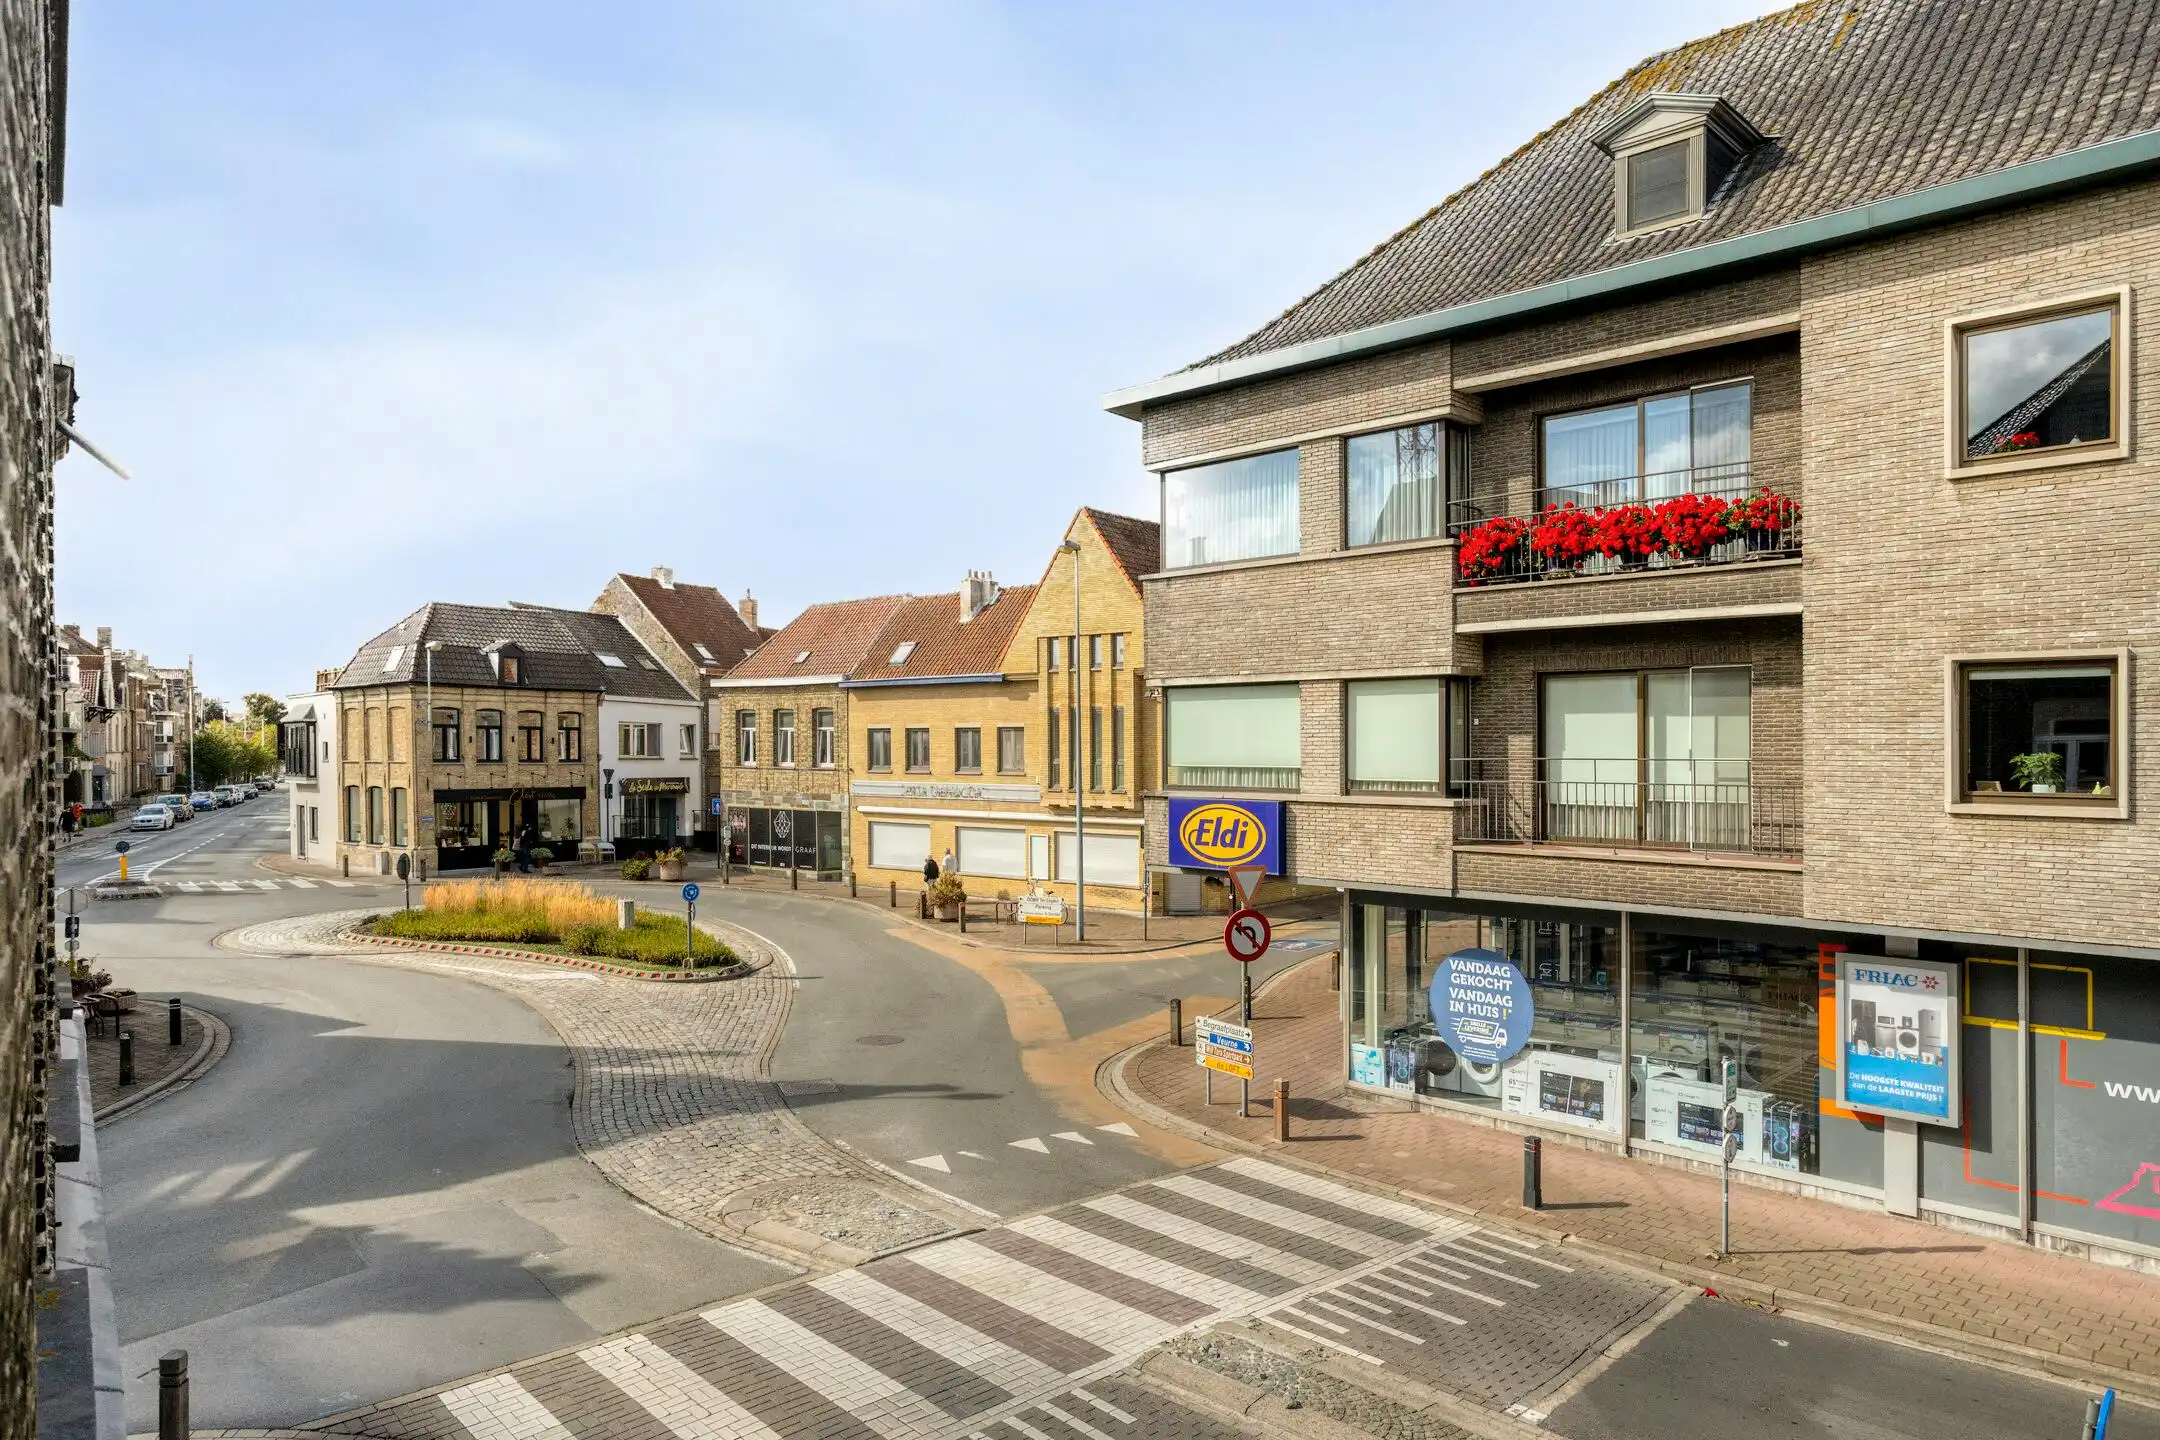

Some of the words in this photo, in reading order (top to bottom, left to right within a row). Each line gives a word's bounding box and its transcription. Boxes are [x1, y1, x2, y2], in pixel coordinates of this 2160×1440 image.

[1195, 816, 1249, 849] Eldi
[1449, 959, 1511, 978] VANDAAG
[1854, 968, 1918, 987] FRIAC
[1450, 973, 1513, 991] GEKOCHT
[1449, 987, 1513, 1007] VANDAAG
[1449, 1001, 1465, 1013] IN
[1467, 1002, 1500, 1018] HUIS
[1202, 1020, 1245, 1037] Begraafplaats
[1216, 1036, 1238, 1049] Veurne
[1849, 1072, 1860, 1081] De
[1861, 1073, 1900, 1086] HOOGSTE
[1901, 1080, 1945, 1093] KWALITEIT
[1852, 1082, 1866, 1090] aan
[1867, 1083, 1878, 1092] de
[1878, 1085, 1914, 1097] LAAGSTE
[1916, 1092, 1938, 1101] PRIJS
